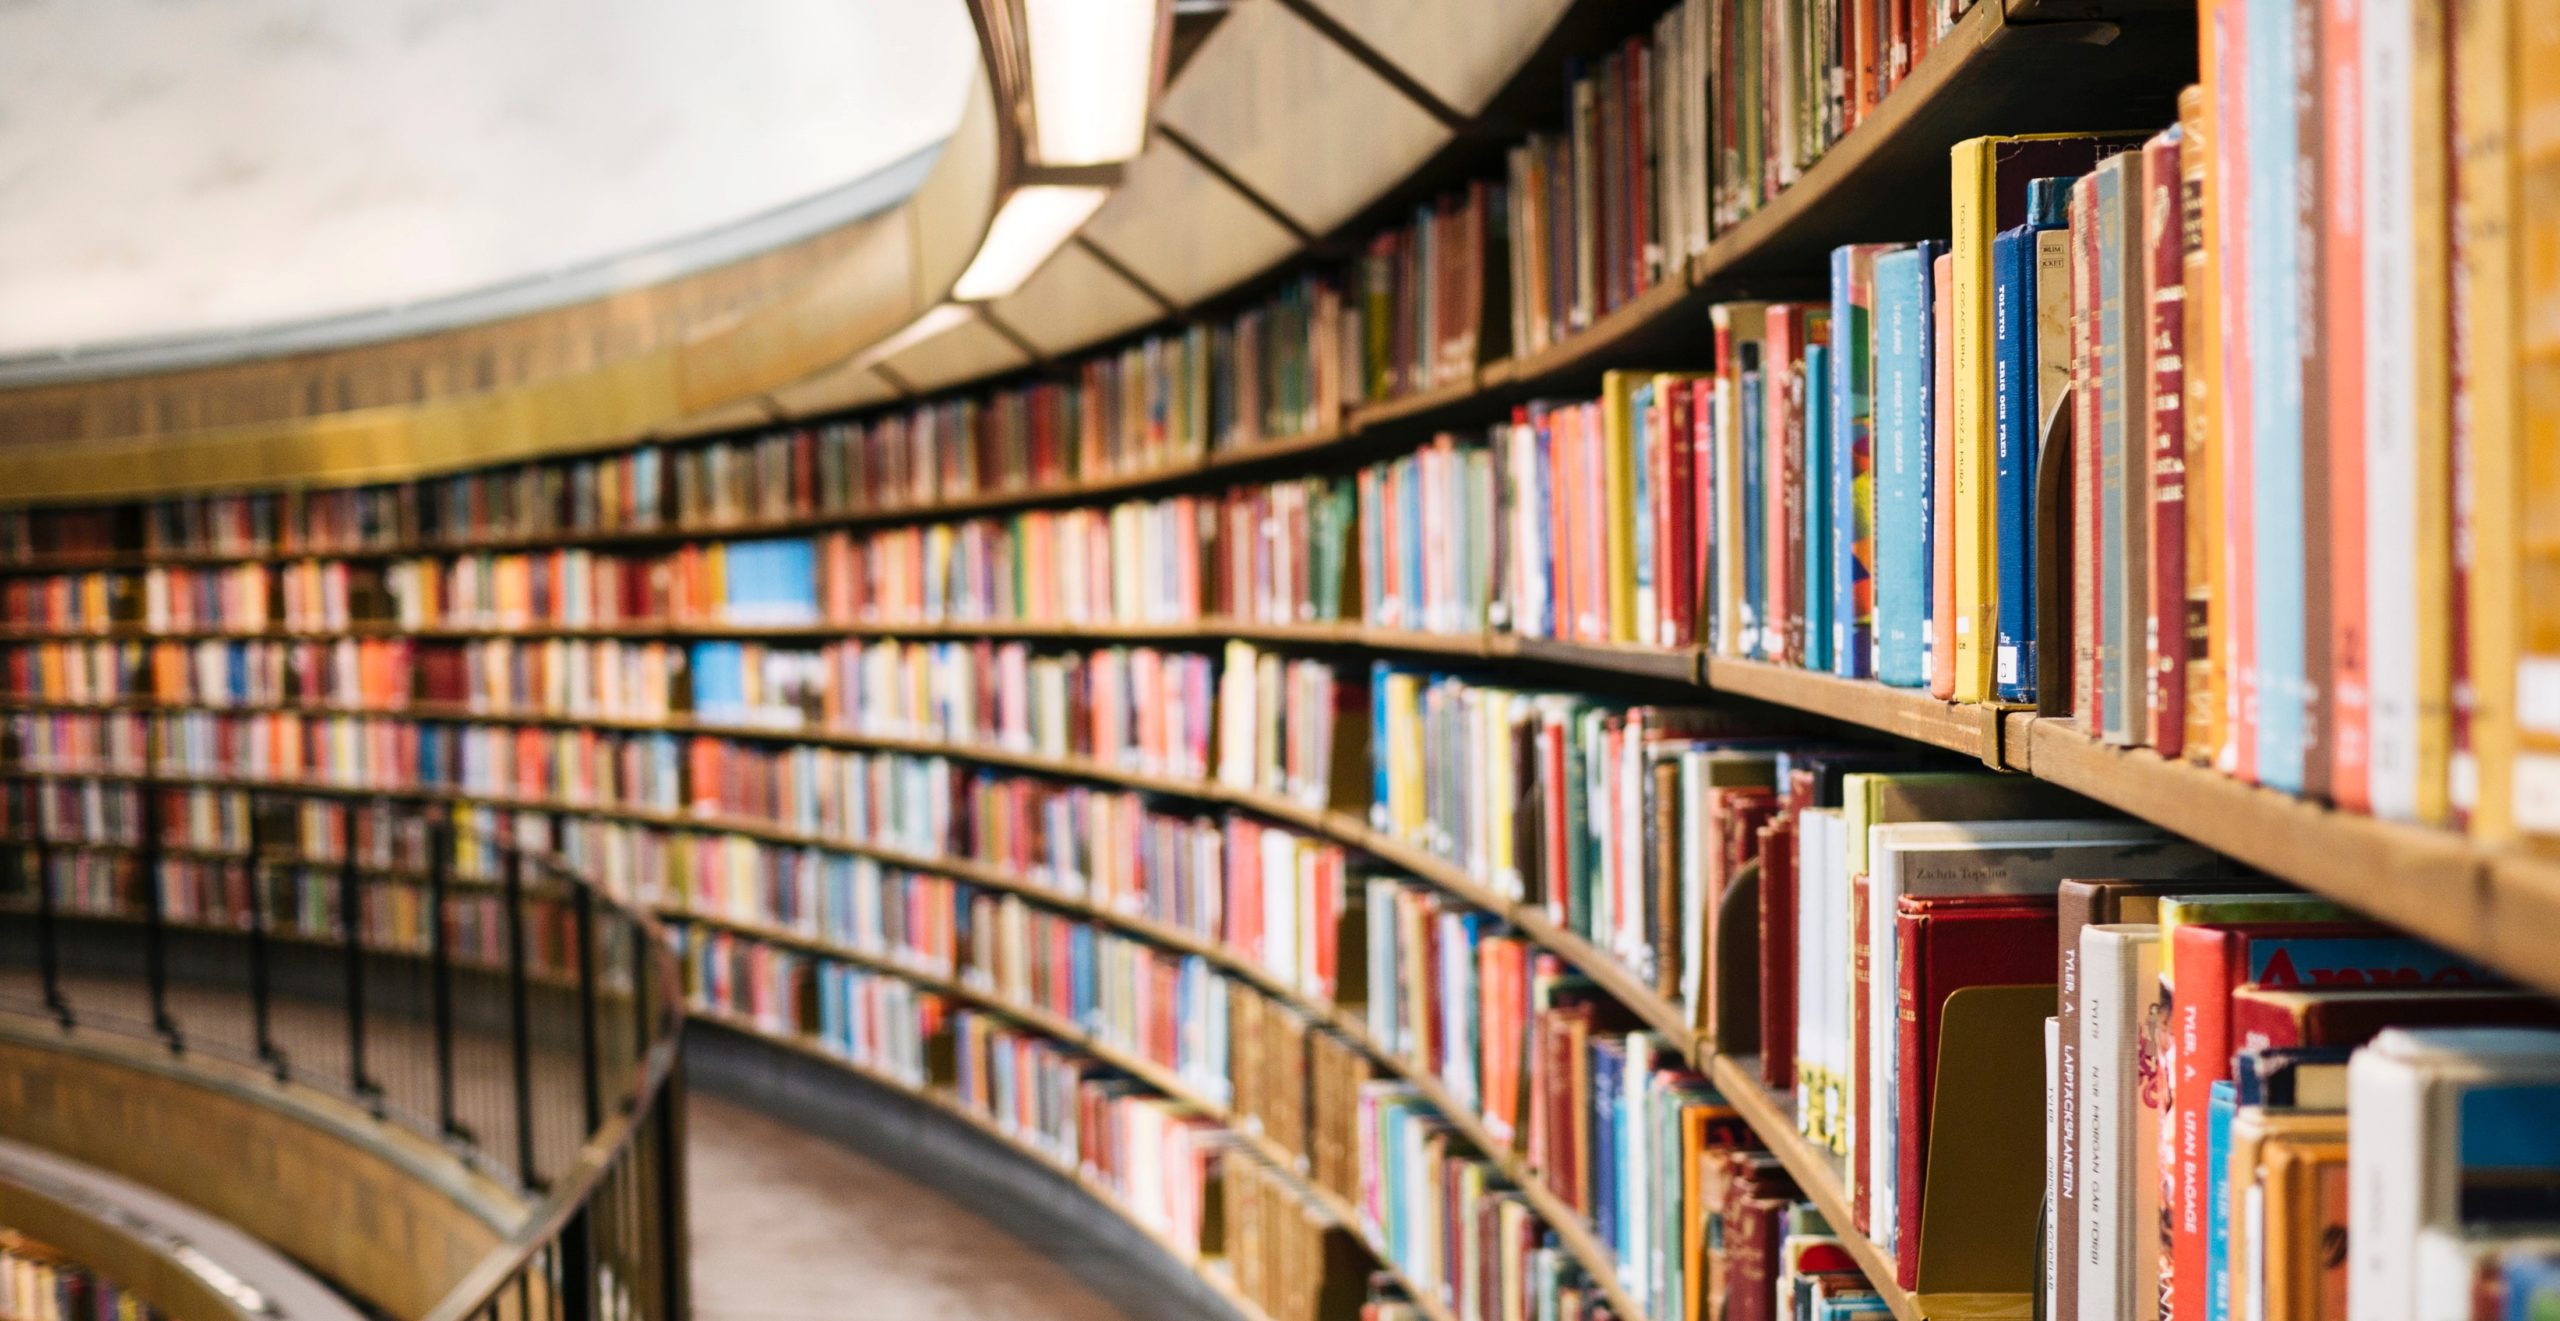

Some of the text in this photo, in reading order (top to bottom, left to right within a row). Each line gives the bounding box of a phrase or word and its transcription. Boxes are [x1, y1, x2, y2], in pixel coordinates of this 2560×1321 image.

[1998, 285, 2006, 340] TOLSTOJ
[1916, 866, 2007, 882] Zachris Topelius
[2064, 949, 2075, 995] TYLER,
[2091, 1000, 2100, 1040] TYLER
[2184, 1005, 2197, 1056] TYLER,
[2063, 1045, 2075, 1199] LAPPTÄCKSPLANETEN
[2091, 1105, 2100, 1173] MORGAN
[2183, 1111, 2197, 1157] UTAN
[2184, 1160, 2197, 1234] BAGAGE
